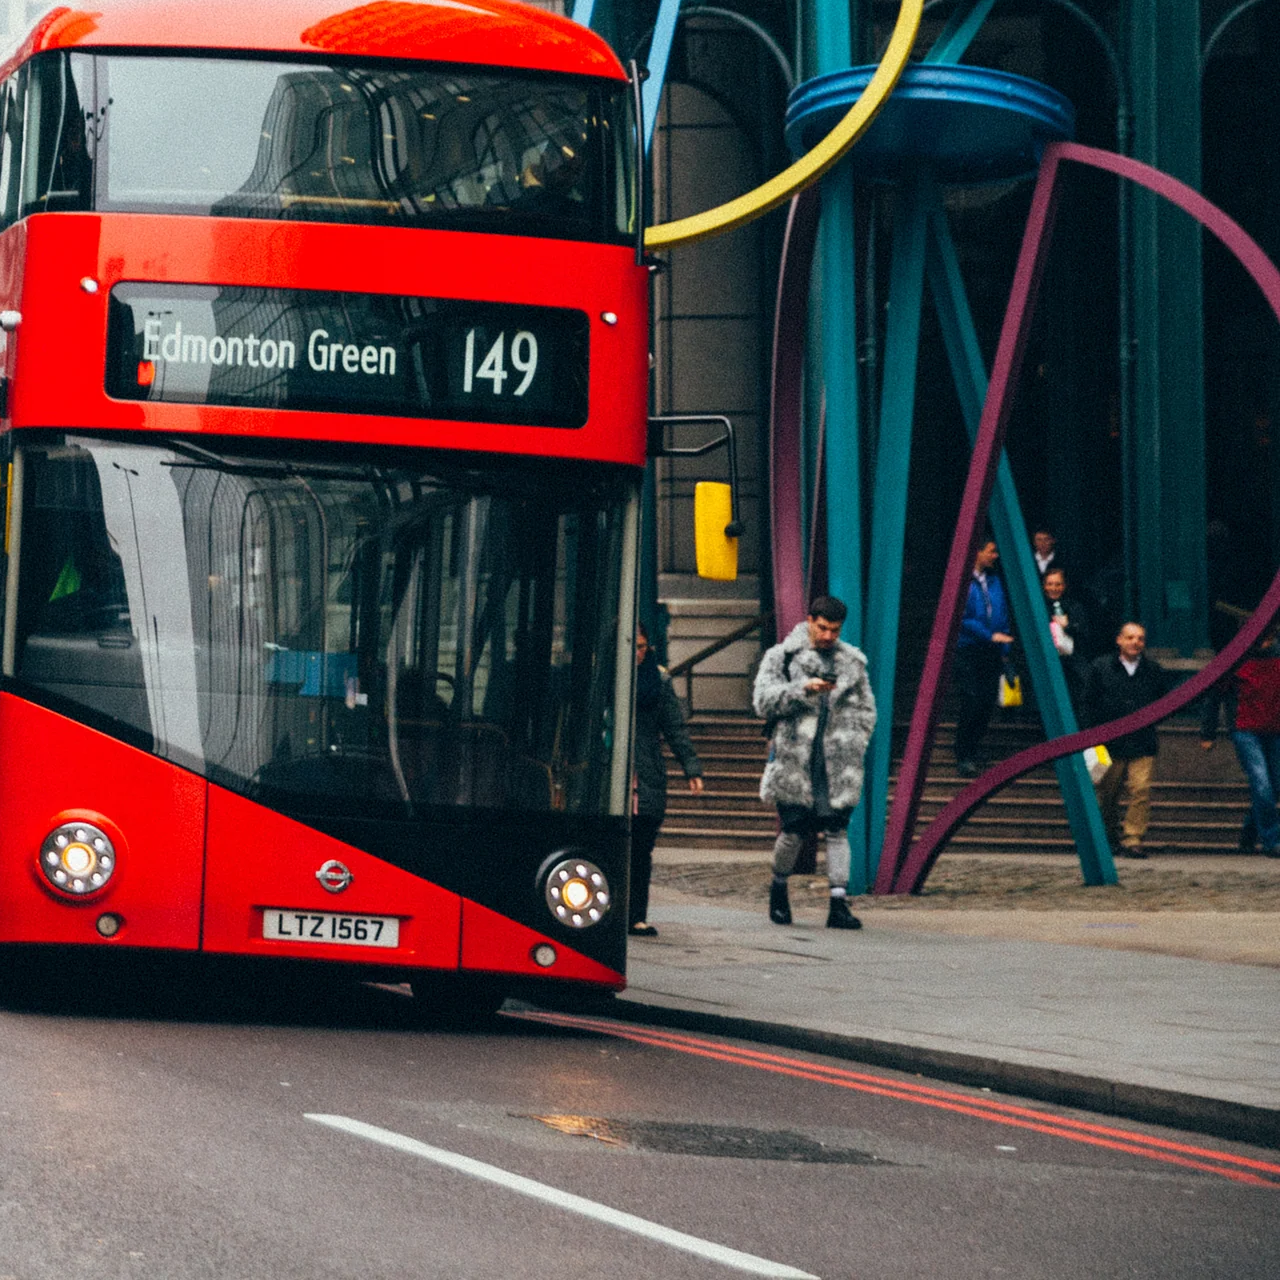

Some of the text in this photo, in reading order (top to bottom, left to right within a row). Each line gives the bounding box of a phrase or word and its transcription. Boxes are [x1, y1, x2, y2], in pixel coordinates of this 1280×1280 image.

[142, 319, 397, 376] Edmonton Green
[462, 328, 539, 397] 149
[278, 913, 384, 942] LTZ 1567
